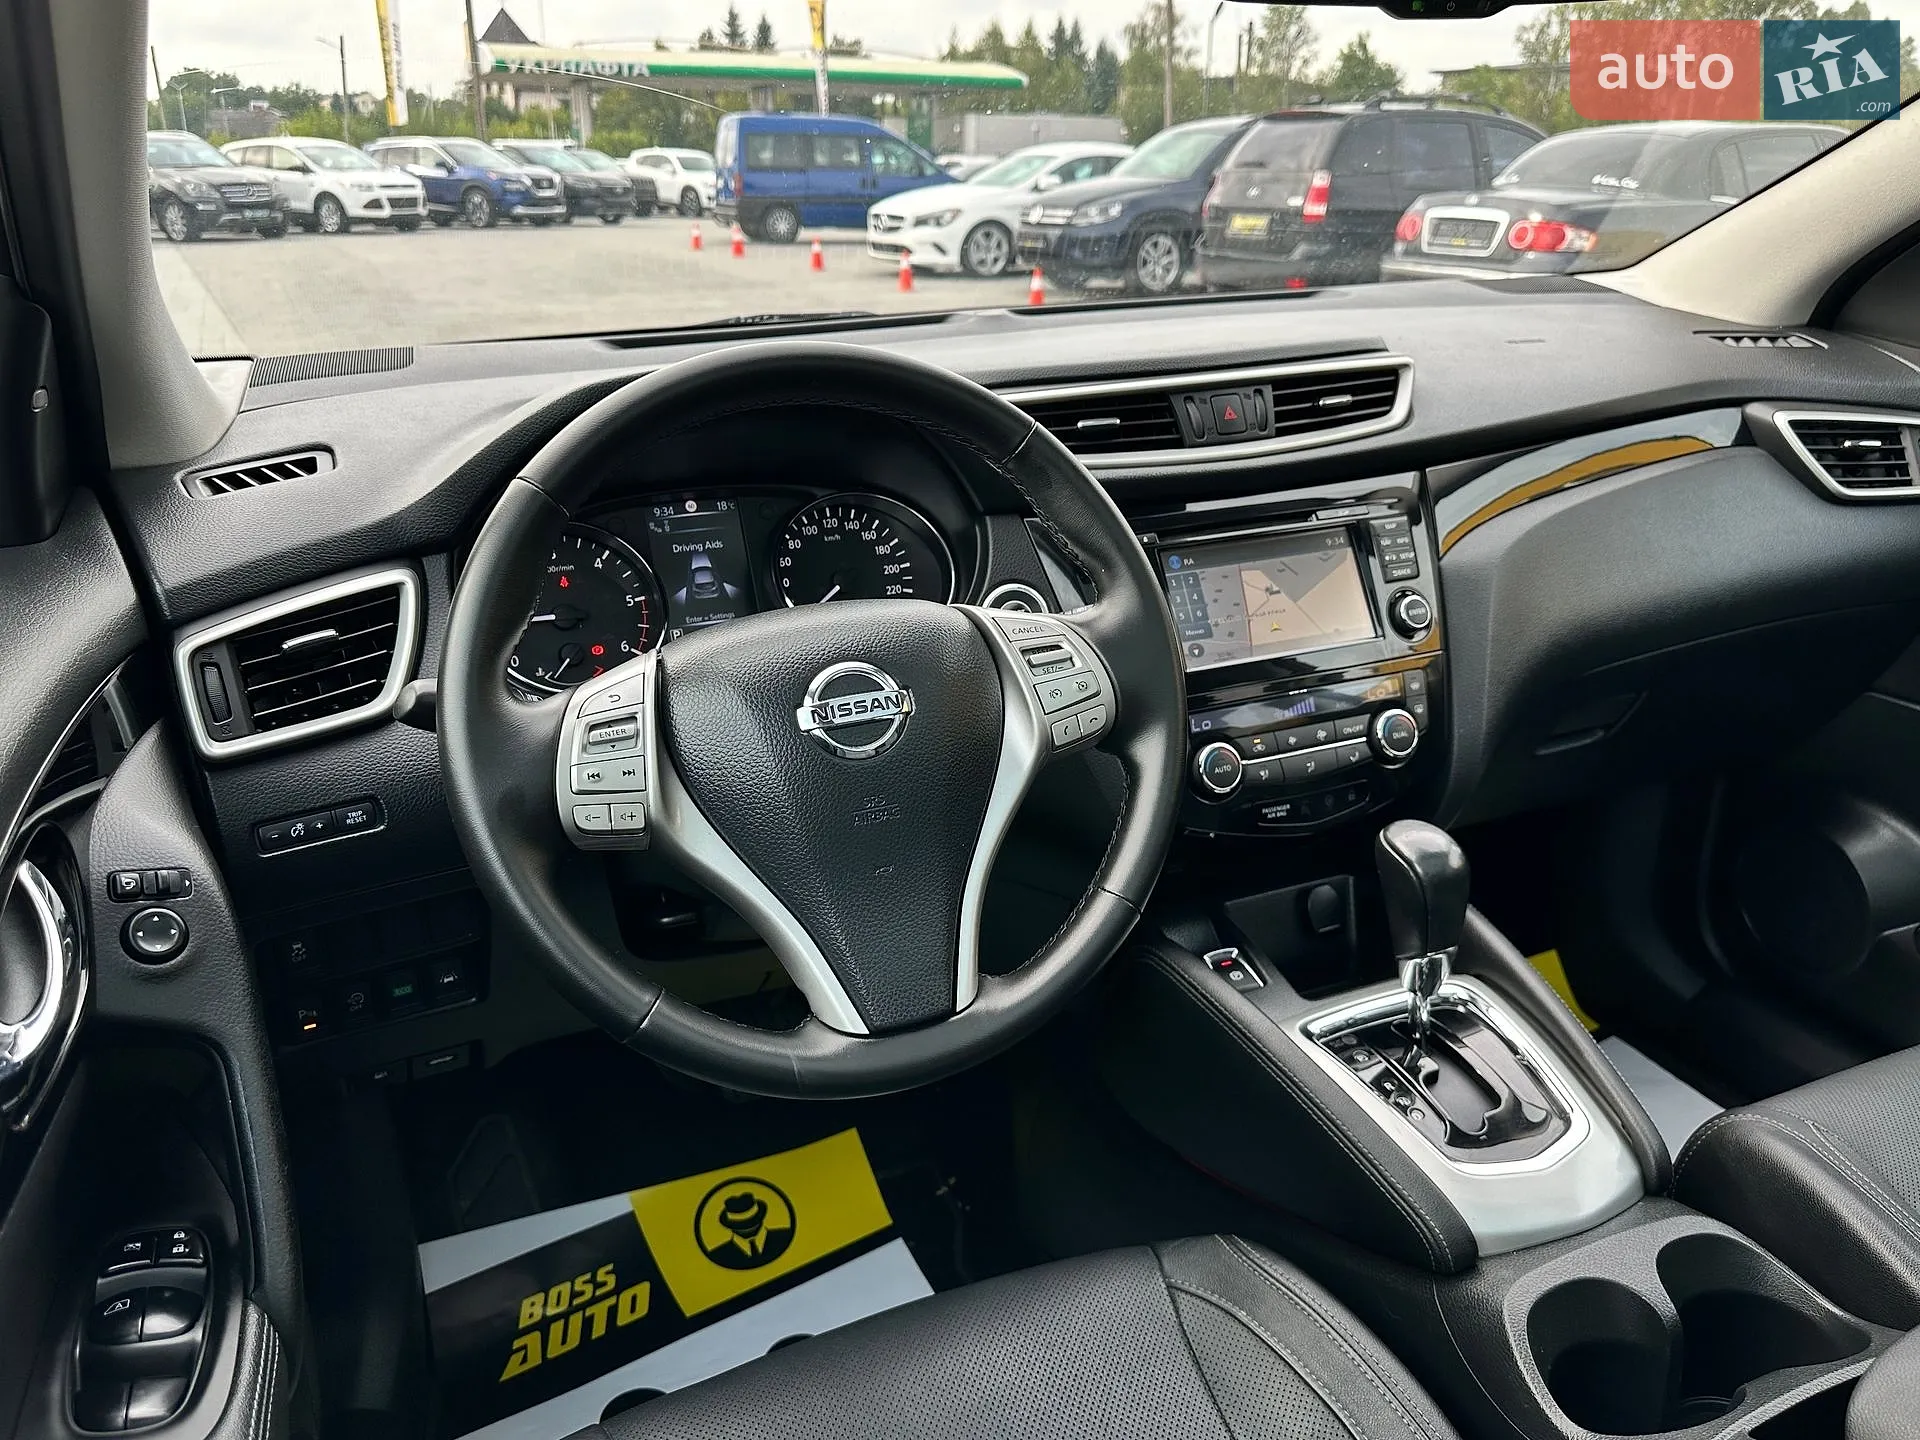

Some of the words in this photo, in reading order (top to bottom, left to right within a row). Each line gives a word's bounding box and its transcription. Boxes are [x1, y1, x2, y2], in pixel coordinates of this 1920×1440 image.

[653, 506, 675, 517] 9:34
[823, 518, 838, 528] 120
[844, 520, 860, 530] 140
[802, 525, 818, 535] 100
[861, 530, 877, 541] 160
[672, 543, 703, 553] Driving
[705, 540, 724, 551] Aids
[788, 539, 801, 549] 80
[875, 545, 891, 555] 180
[594, 557, 602, 569] 4
[884, 564, 900, 574] 200
[886, 585, 902, 595] 220
[626, 594, 634, 606] 5
[1012, 626, 1044, 635] CANCEL
[621, 641, 629, 652] 6
[510, 656, 519, 667] 0
[810, 694, 900, 722] NISSAN
[599, 728, 627, 739] ENTER
[1214, 764, 1232, 774] AUTO
[348, 810, 363, 818] TRIP
[346, 815, 367, 824] RESET
[518, 1263, 617, 1329] BOSS
[499, 1281, 651, 1382] AUTO
